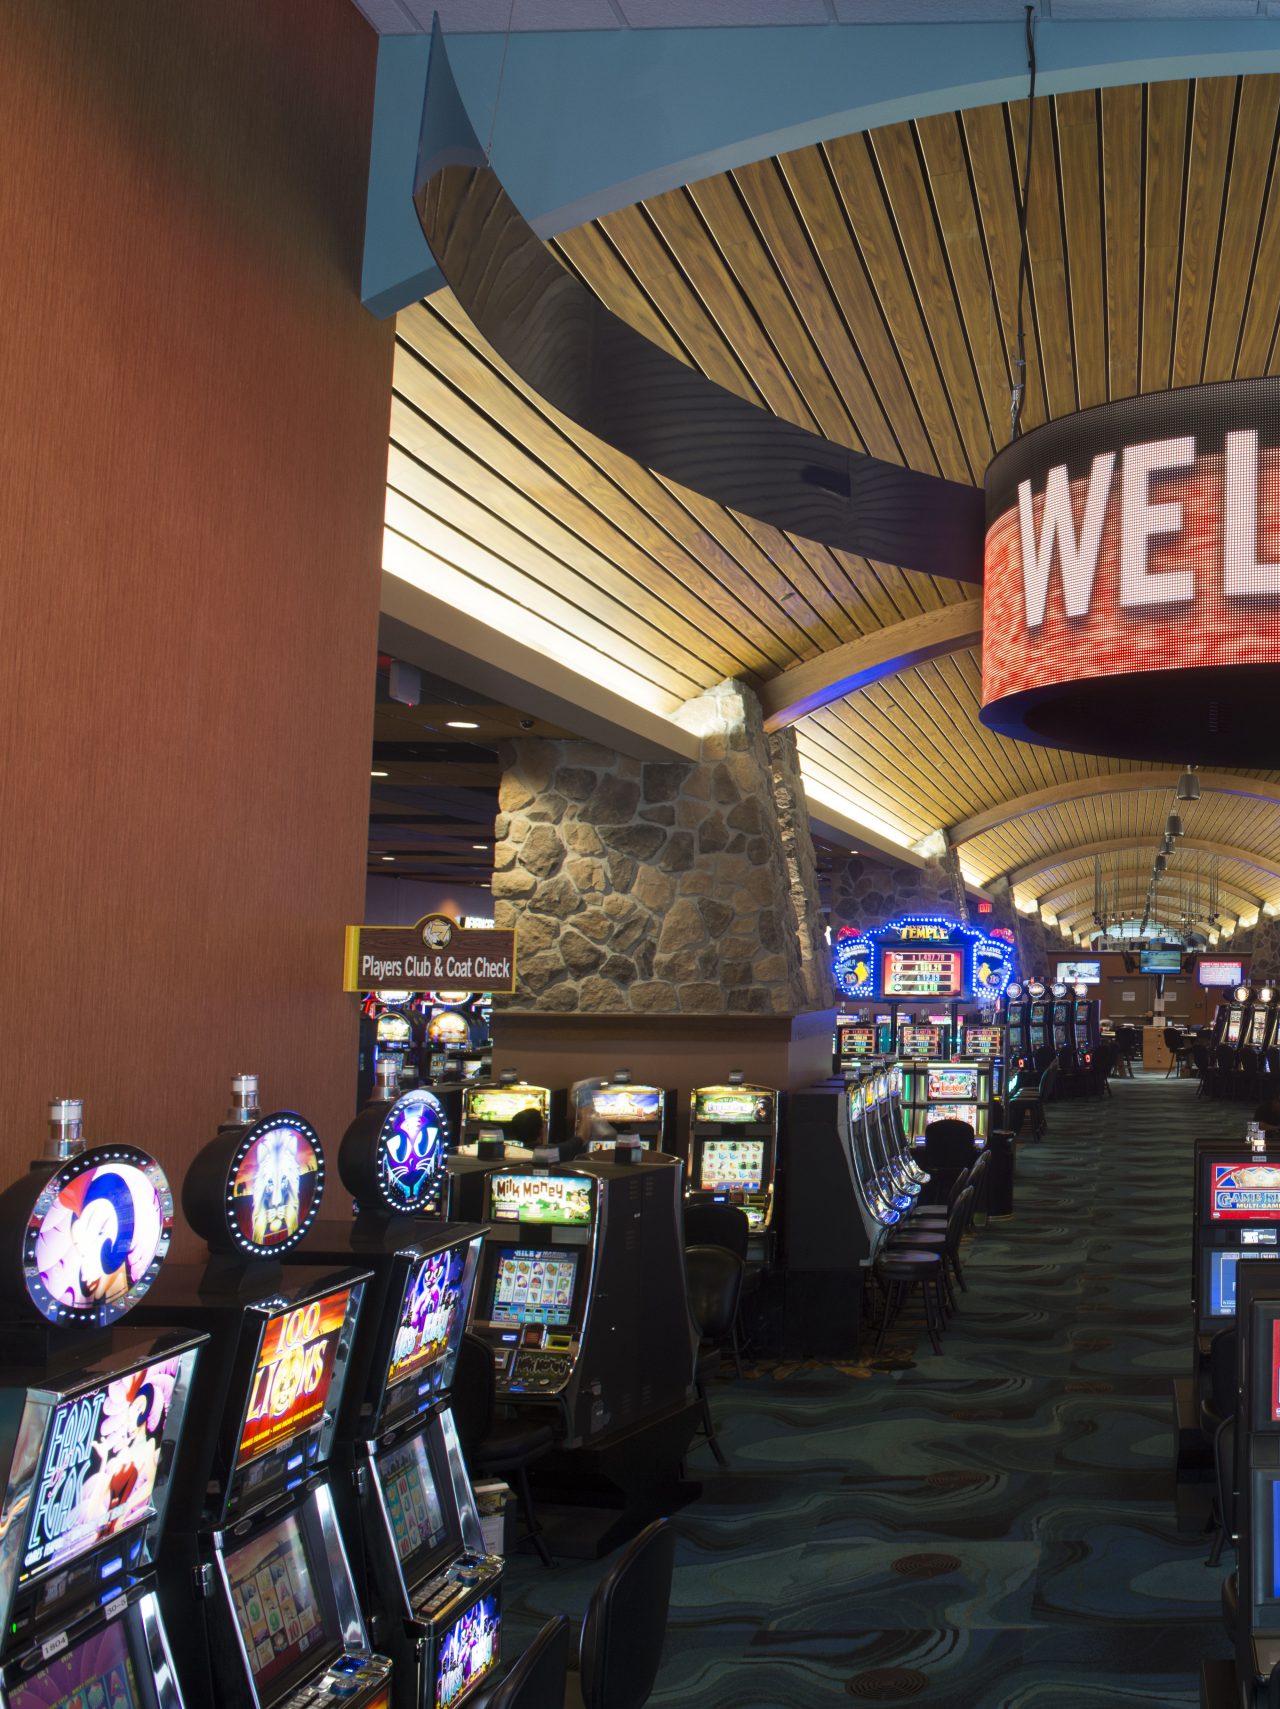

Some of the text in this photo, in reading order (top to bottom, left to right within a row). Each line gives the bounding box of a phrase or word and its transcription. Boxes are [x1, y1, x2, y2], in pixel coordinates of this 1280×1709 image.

[901, 926, 949, 940] TEMPLE
[362, 955, 510, 981] Players Club & Coat Check
[497, 1178, 564, 1198] Milk Money
[1217, 1192, 1262, 1208] GAME
[278, 1302, 321, 1352] 100
[247, 1340, 328, 1422] LIONS
[249, 1601, 260, 1621] 9
[269, 1611, 279, 1631] 9
[44, 1637, 66, 1655] 1804
